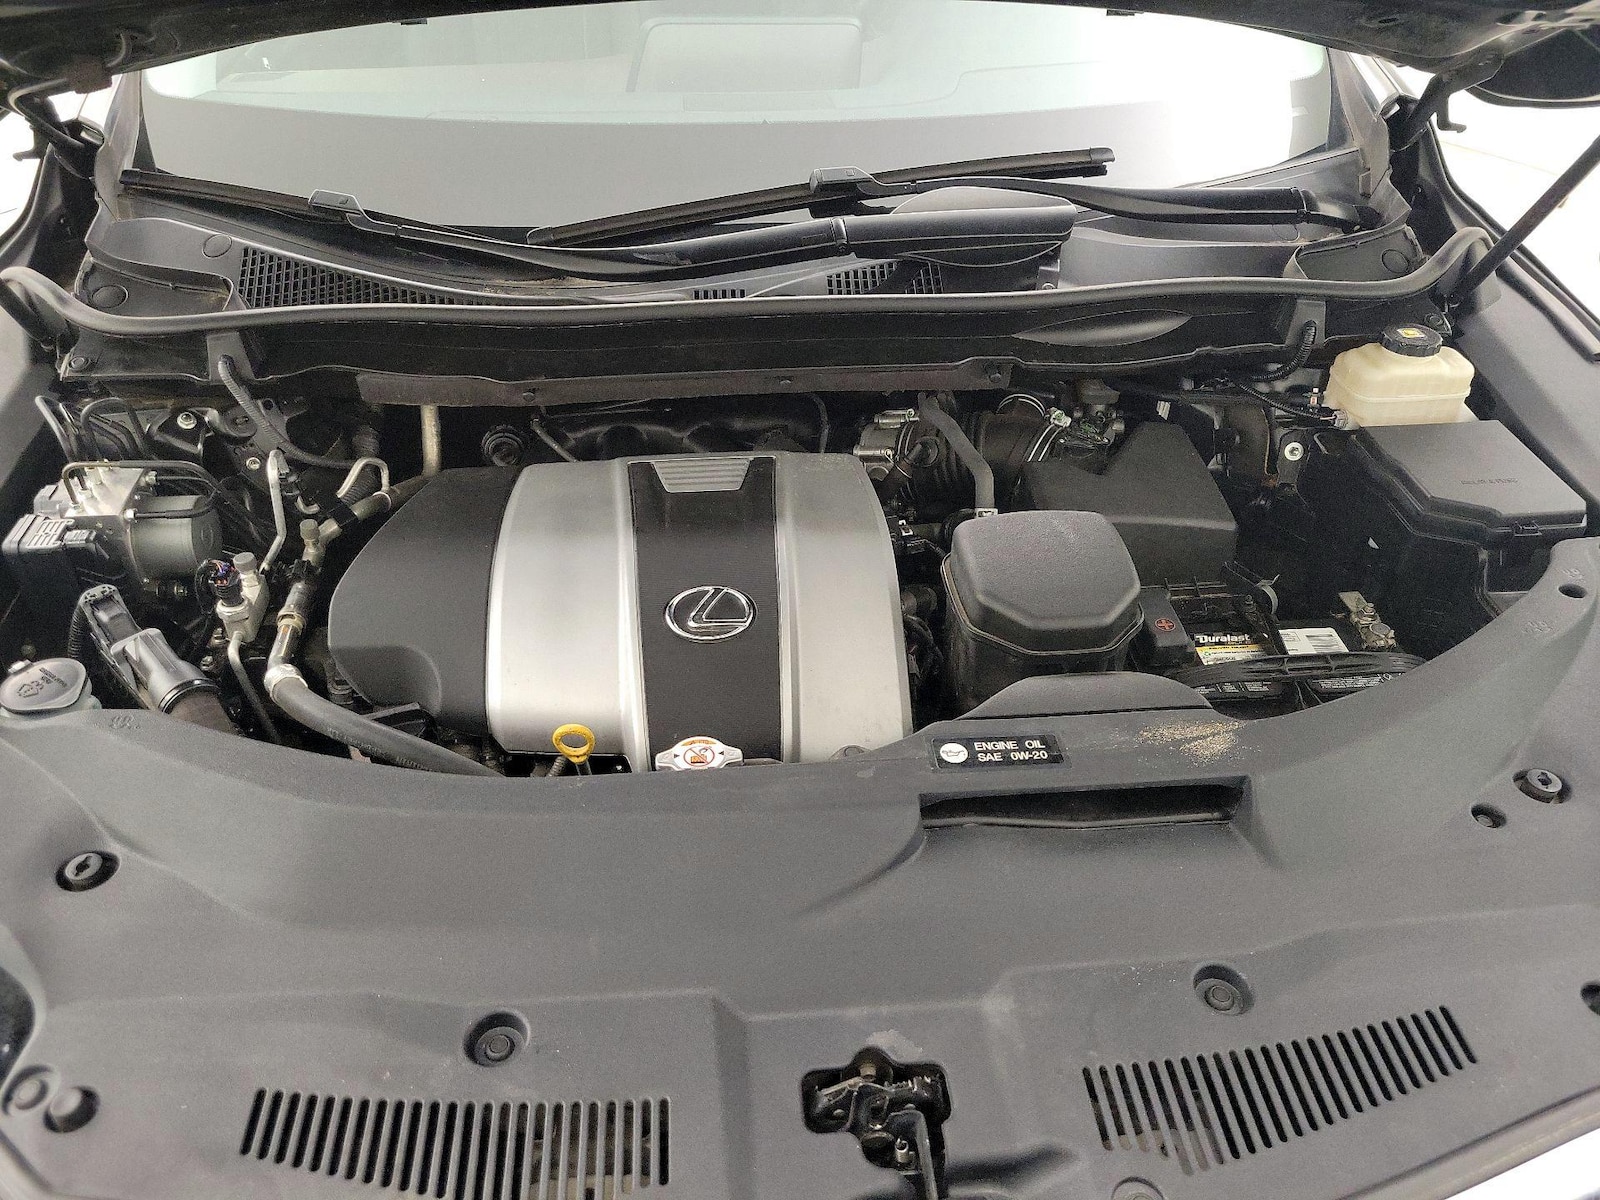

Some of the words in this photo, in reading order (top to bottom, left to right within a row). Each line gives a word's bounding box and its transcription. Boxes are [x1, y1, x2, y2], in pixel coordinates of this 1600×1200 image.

[1195, 634, 1251, 644] Duralast
[974, 740, 1019, 751] ENGINE
[1025, 739, 1046, 749] OIL
[977, 752, 1003, 762] SAE
[1010, 750, 1048, 760] 0W-20
